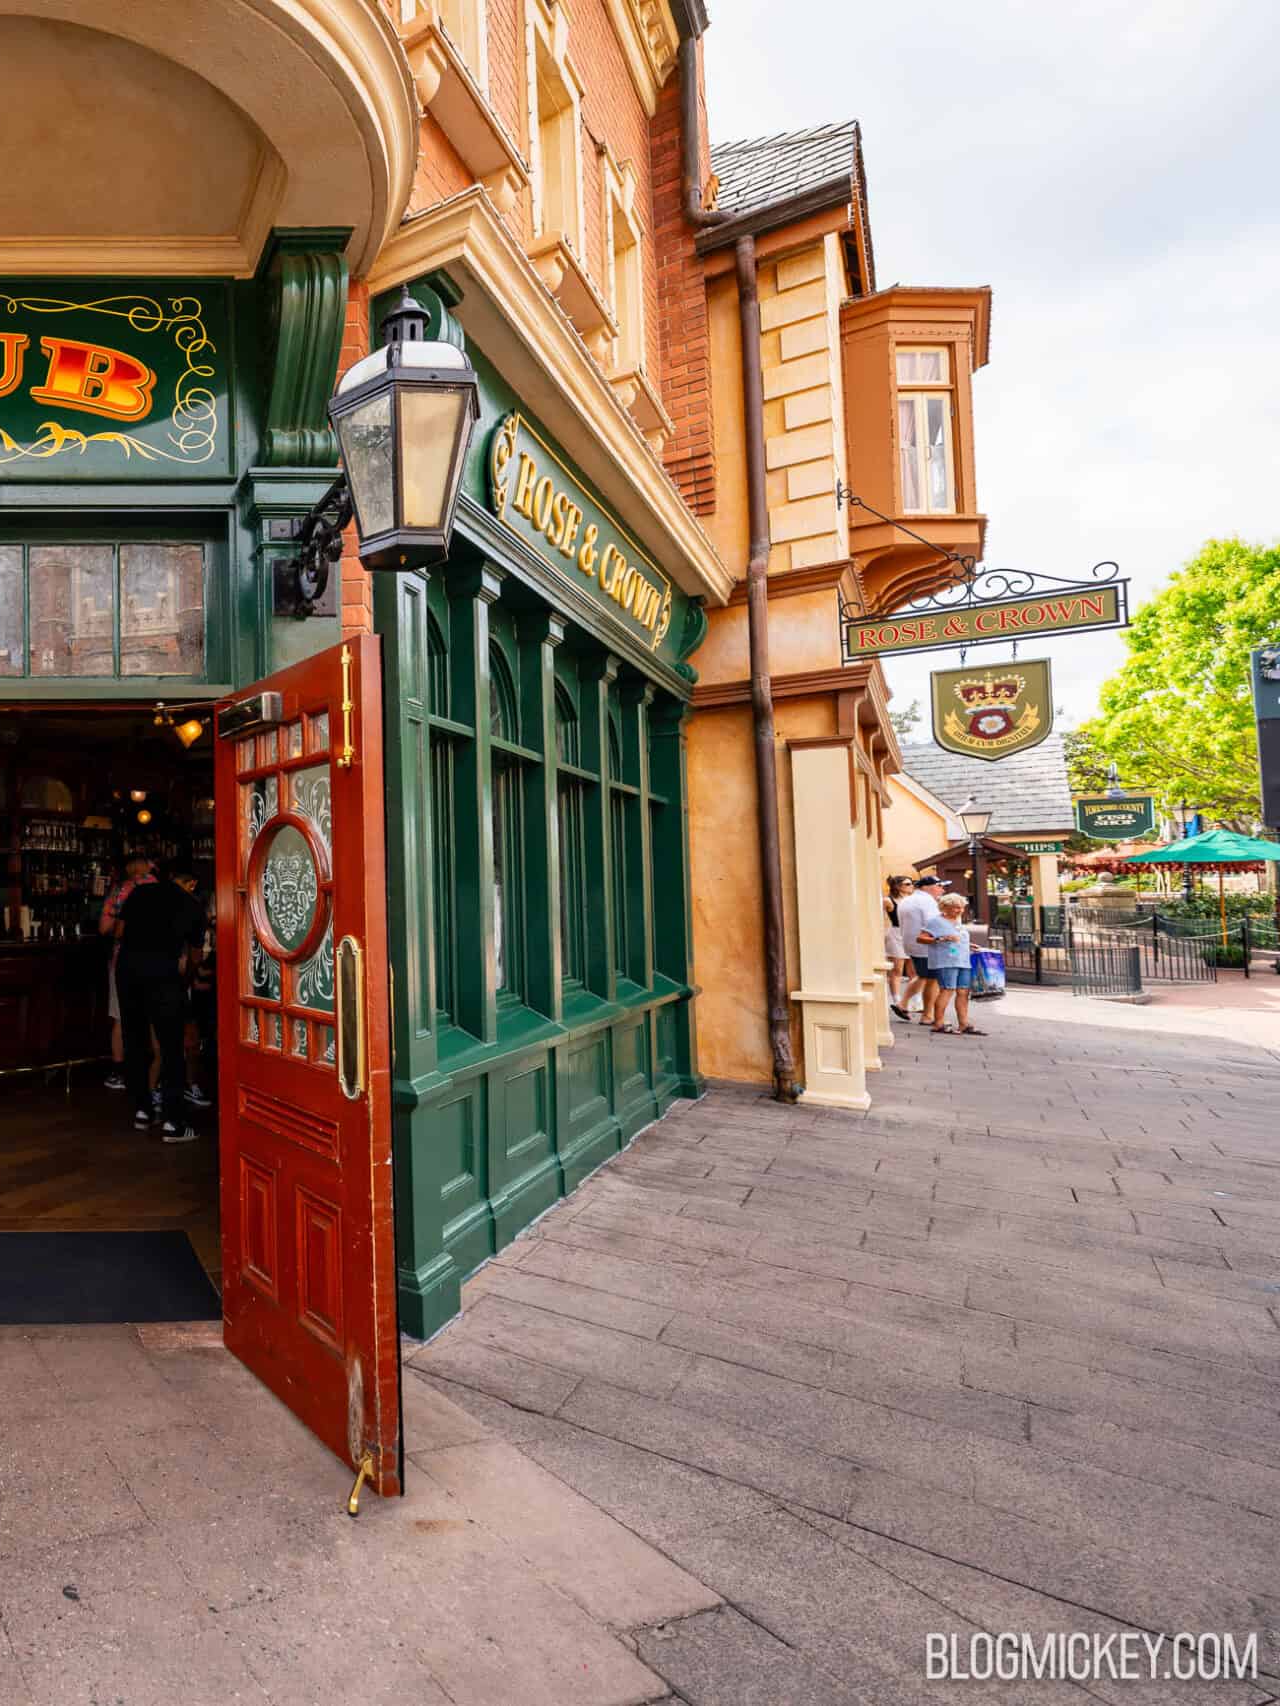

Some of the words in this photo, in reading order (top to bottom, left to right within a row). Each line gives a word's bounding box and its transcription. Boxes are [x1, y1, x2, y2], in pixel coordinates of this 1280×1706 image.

[513, 451, 583, 560] ROSE
[578, 524, 598, 577] &
[599, 543, 661, 631] CROWN
[857, 619, 938, 649] ROSE
[943, 615, 969, 638] &
[975, 595, 1105, 633] CROWN
